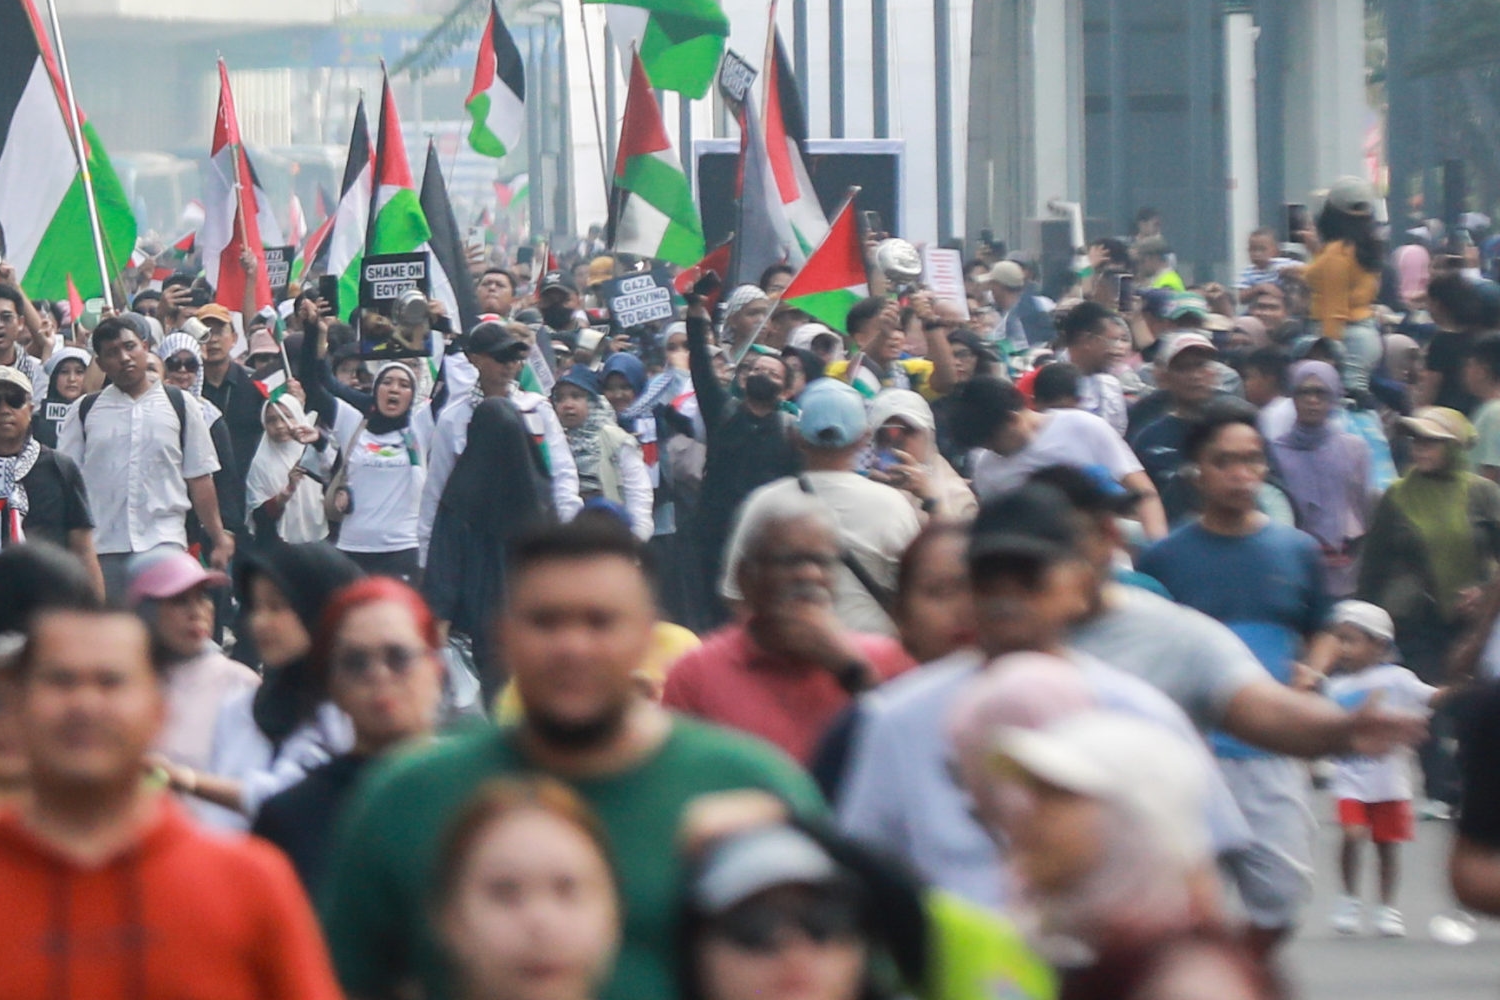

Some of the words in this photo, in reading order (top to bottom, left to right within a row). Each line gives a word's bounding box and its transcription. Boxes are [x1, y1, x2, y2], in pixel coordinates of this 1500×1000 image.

[367, 265, 406, 279] SHAME
[407, 264, 423, 277] ON
[623, 278, 654, 292] GAZA
[615, 290, 668, 312] STARVING
[620, 313, 635, 326] TO
[636, 305, 670, 321] DEATH
[48, 404, 71, 418] IND
